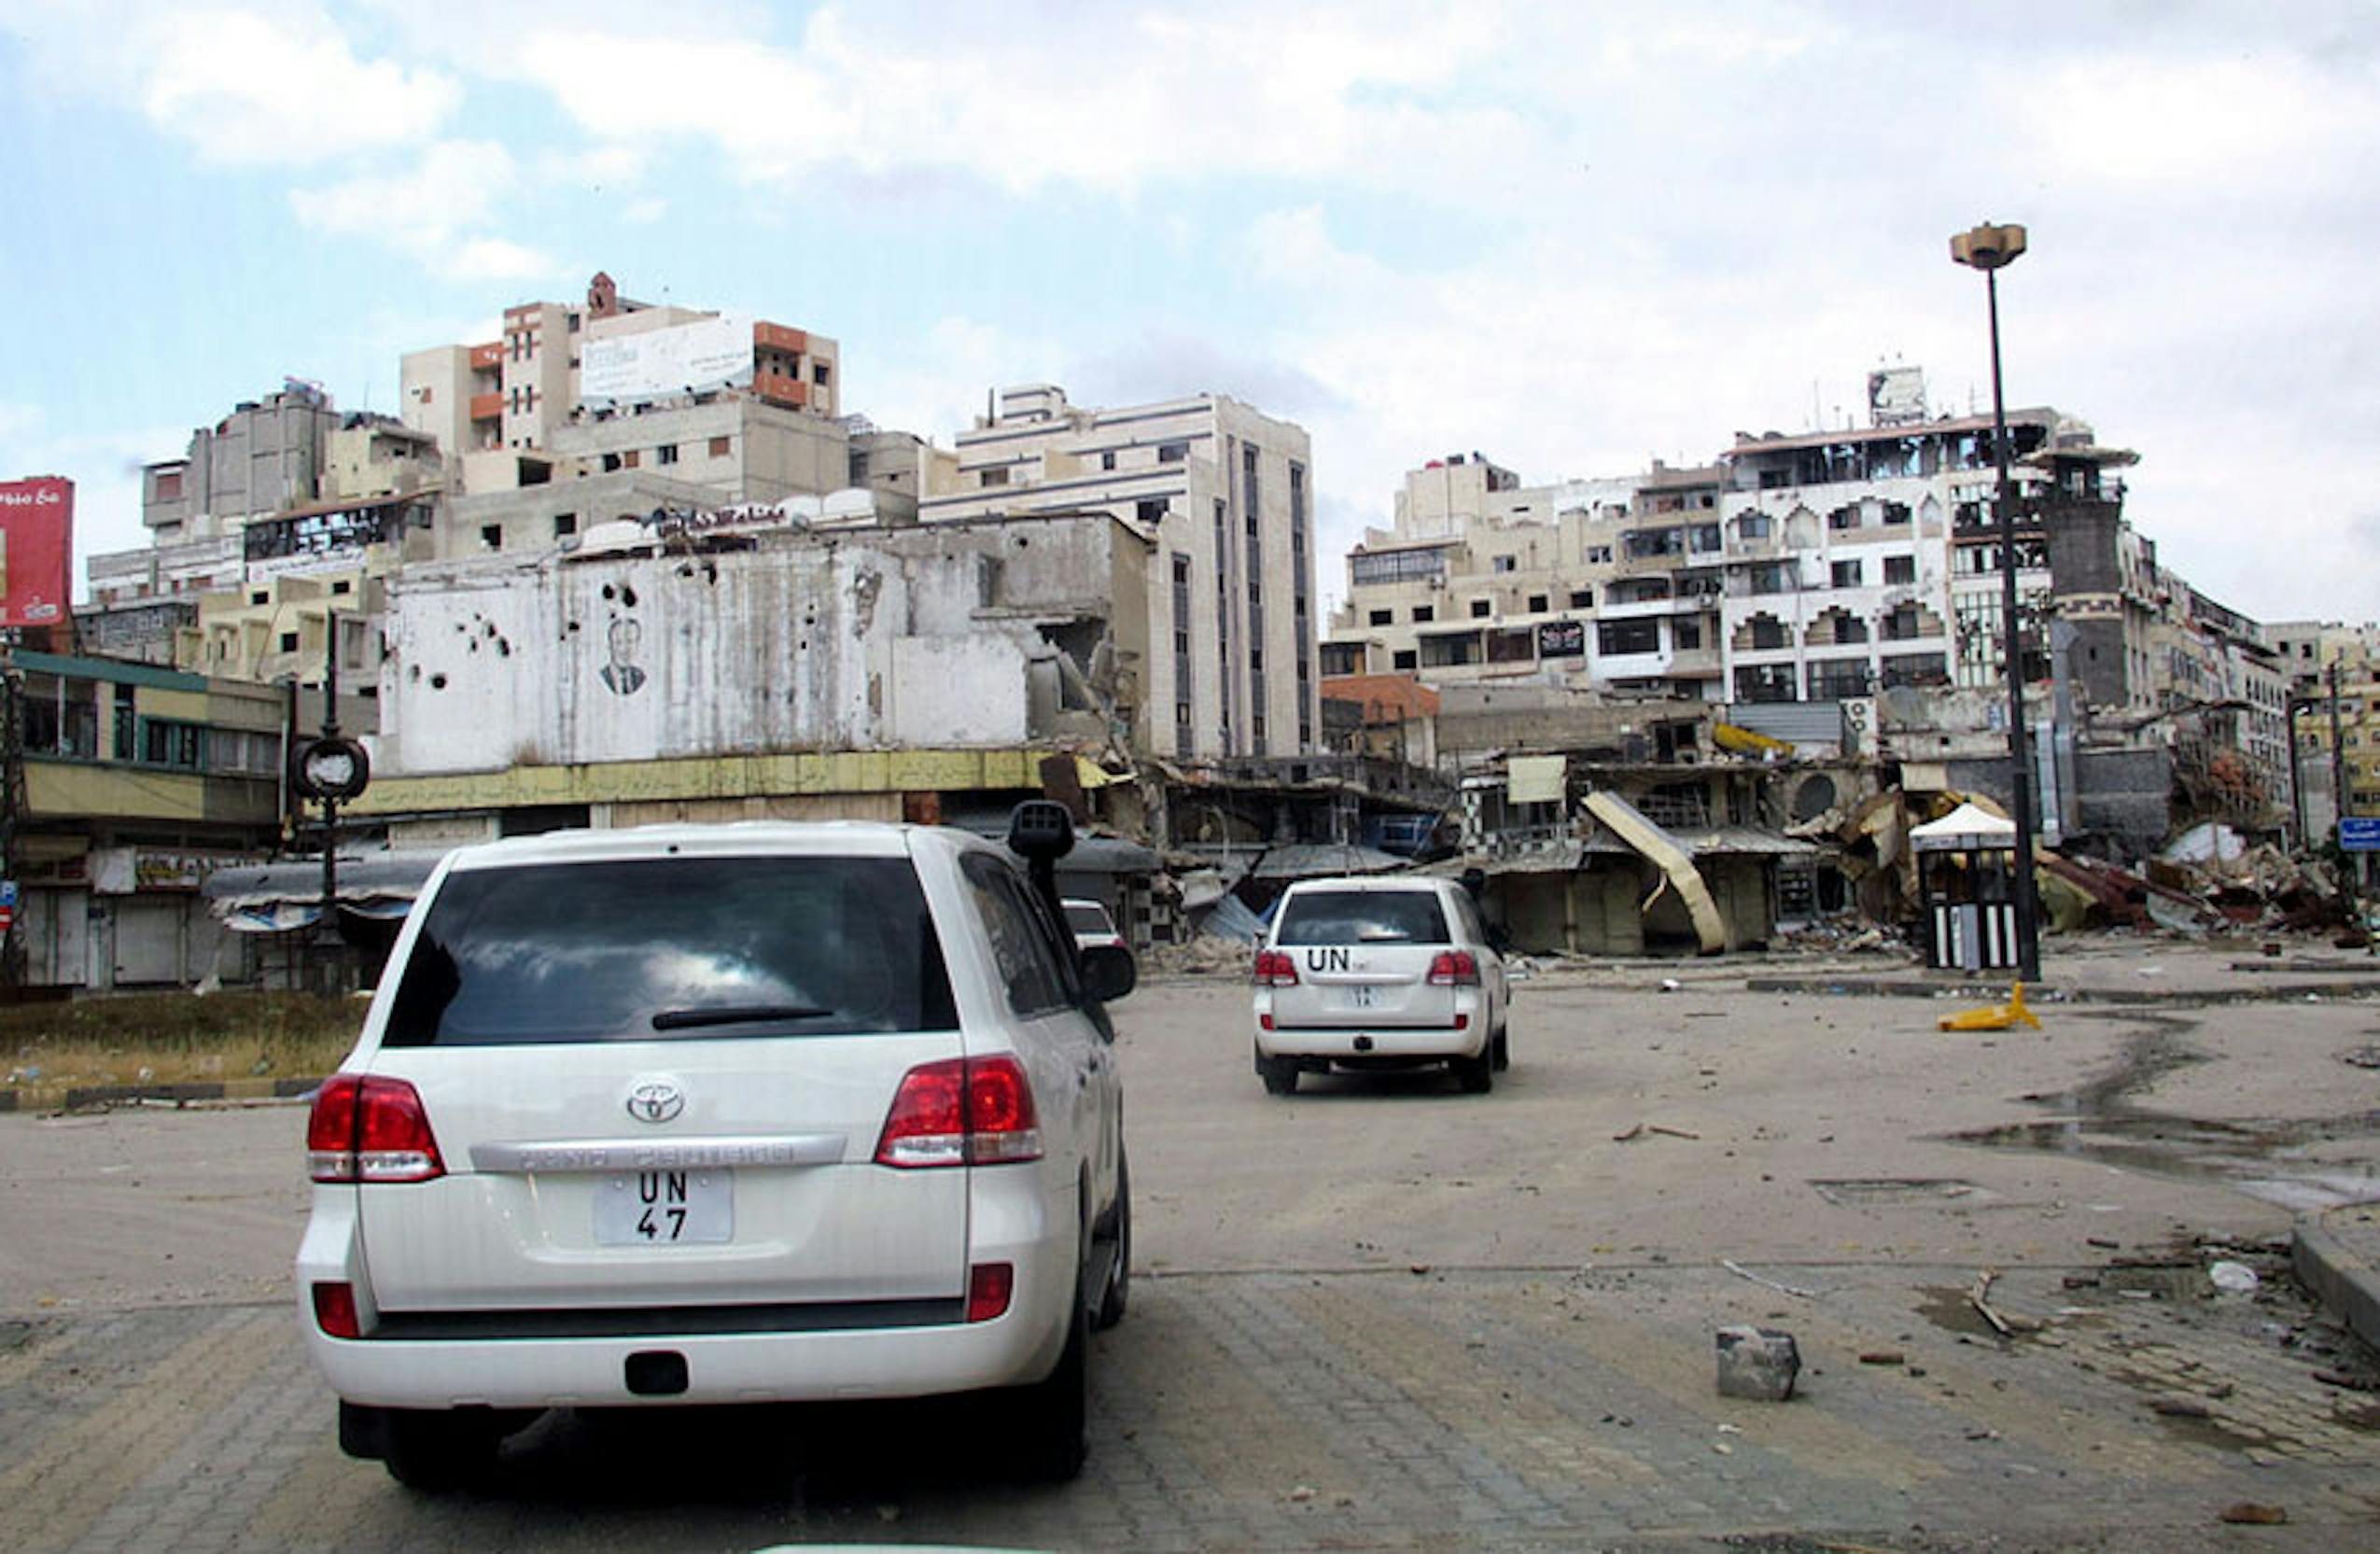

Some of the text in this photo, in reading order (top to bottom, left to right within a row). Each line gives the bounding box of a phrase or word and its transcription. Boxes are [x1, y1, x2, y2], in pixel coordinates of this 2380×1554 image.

[1308, 948, 1349, 972] UN
[639, 1169, 687, 1203] UN
[637, 1209, 687, 1240] 47
